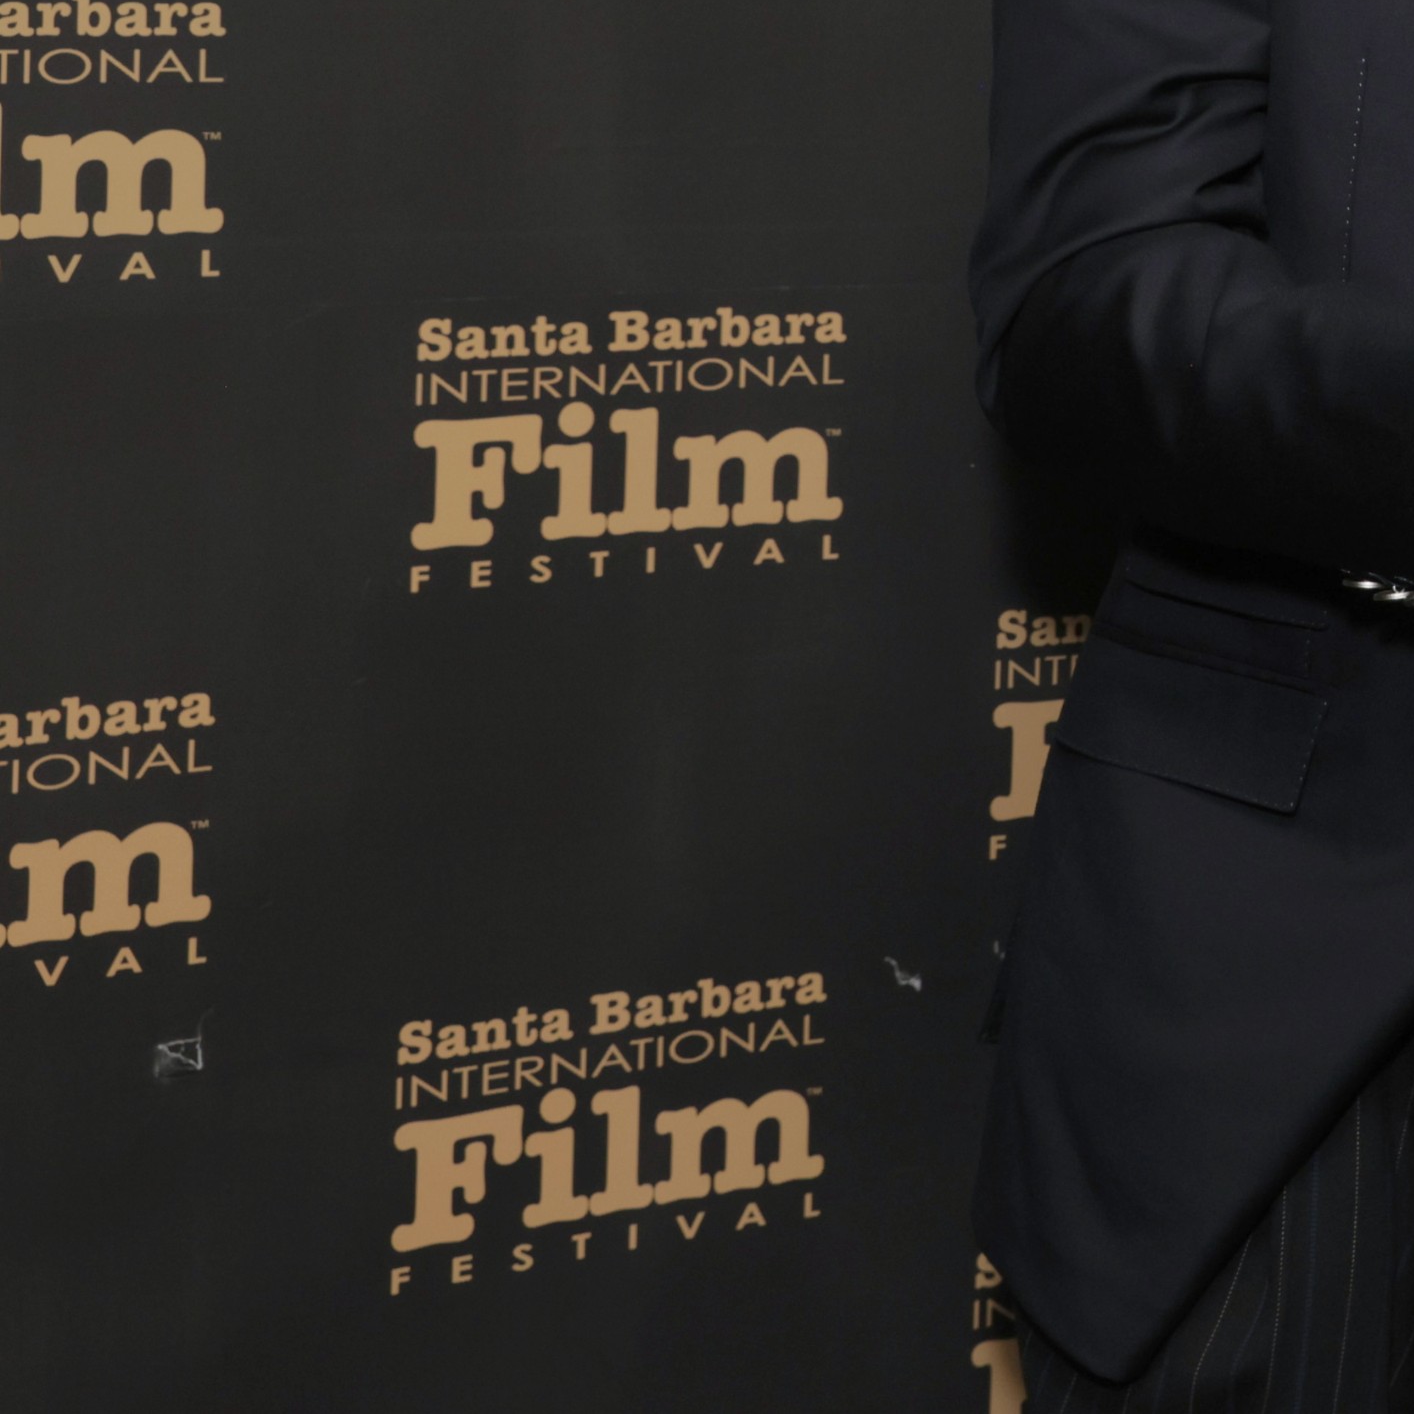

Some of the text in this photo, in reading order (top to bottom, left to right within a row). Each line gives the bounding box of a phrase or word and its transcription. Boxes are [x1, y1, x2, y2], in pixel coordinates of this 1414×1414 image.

[417, 307, 847, 361] Santa Barbara
[416, 354, 842, 405] INTERNATIONAL
[411, 402, 843, 550] Film
[410, 535, 838, 593] FESTIVAL
[996, 609, 1092, 650] San
[0, 693, 215, 749] arbara
[398, 973, 826, 1065] Santa Barbara
[396, 1016, 822, 1109] INTERNATIONAL
[391, 1086, 824, 1252] Film
[391, 1194, 820, 1295] FESTIVAL
